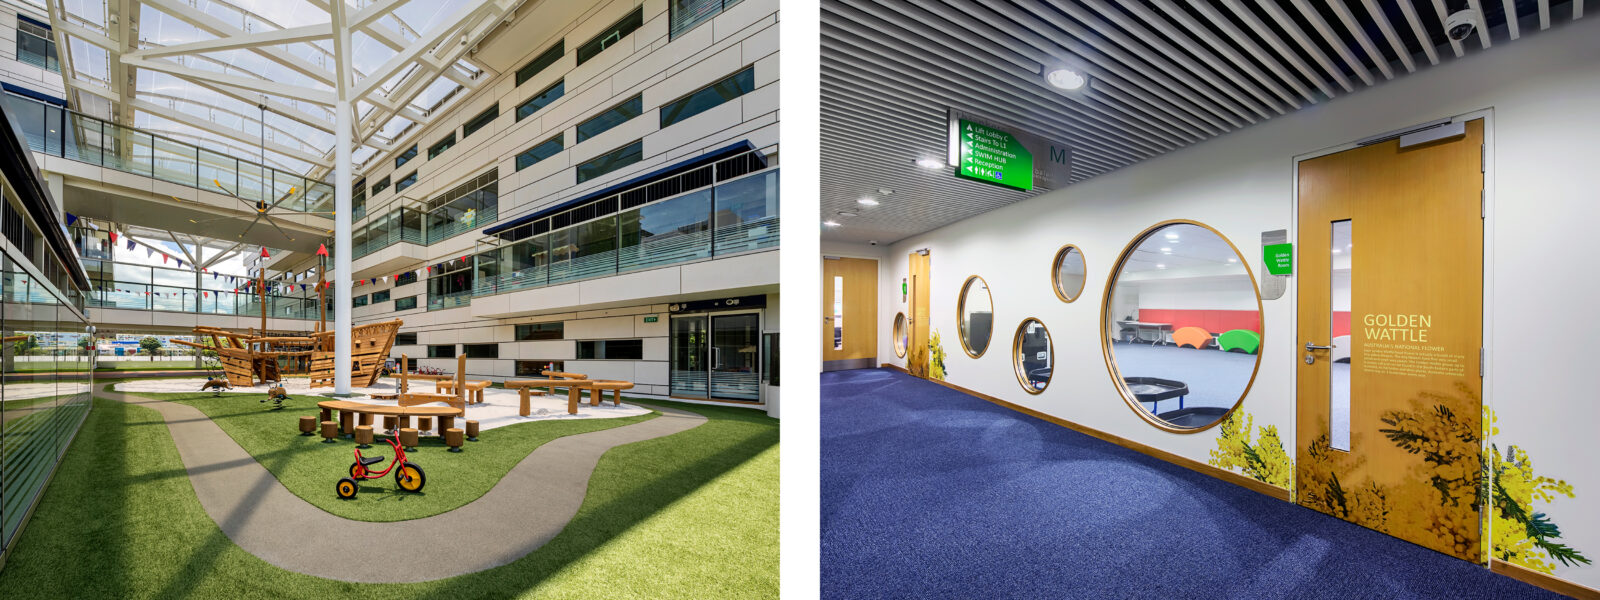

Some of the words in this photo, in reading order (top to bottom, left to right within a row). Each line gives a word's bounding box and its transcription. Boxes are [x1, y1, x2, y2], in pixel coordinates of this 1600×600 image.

[975, 127, 985, 135] Lift
[986, 129, 1003, 140] Lobby
[975, 135, 991, 144] Stairs
[1000, 141, 1007, 149] L1
[975, 143, 1016, 159] Administration
[975, 150, 993, 160] SWIM
[994, 155, 1007, 164] HUB
[1050, 145, 1066, 165] M
[974, 158, 1004, 170] Reception
[1363, 313, 1431, 328] GOLDEN
[1364, 327, 1428, 343] WATTLE
